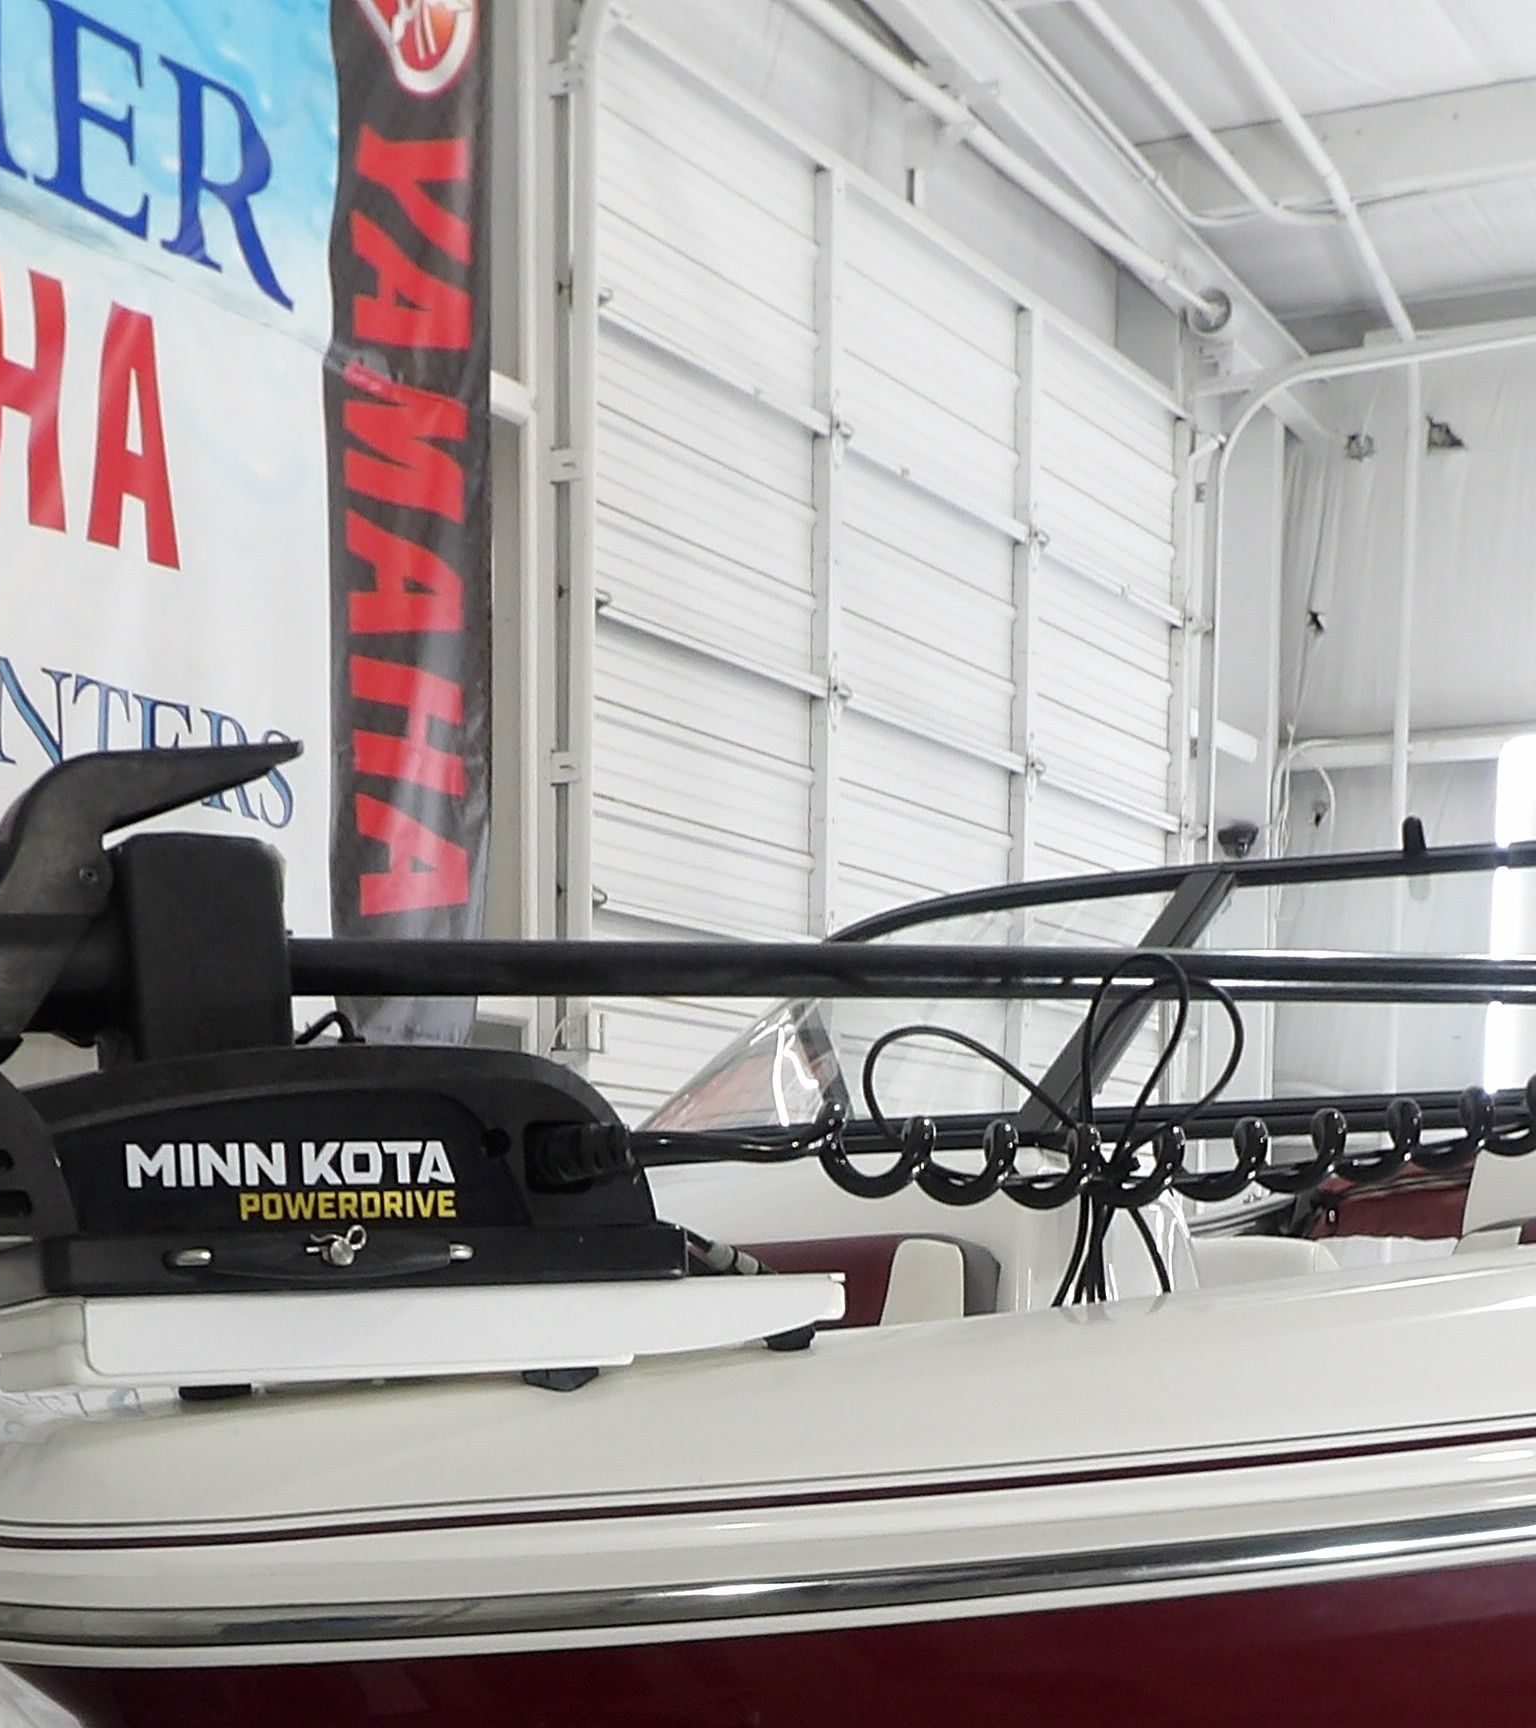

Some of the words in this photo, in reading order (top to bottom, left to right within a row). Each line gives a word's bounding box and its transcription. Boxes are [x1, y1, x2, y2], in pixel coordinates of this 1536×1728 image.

[344, 122, 472, 918] YAMAHA
[125, 1142, 287, 1188] MINN
[302, 1140, 456, 1186] KOTA
[240, 1190, 457, 1221] POWERDRIVE
